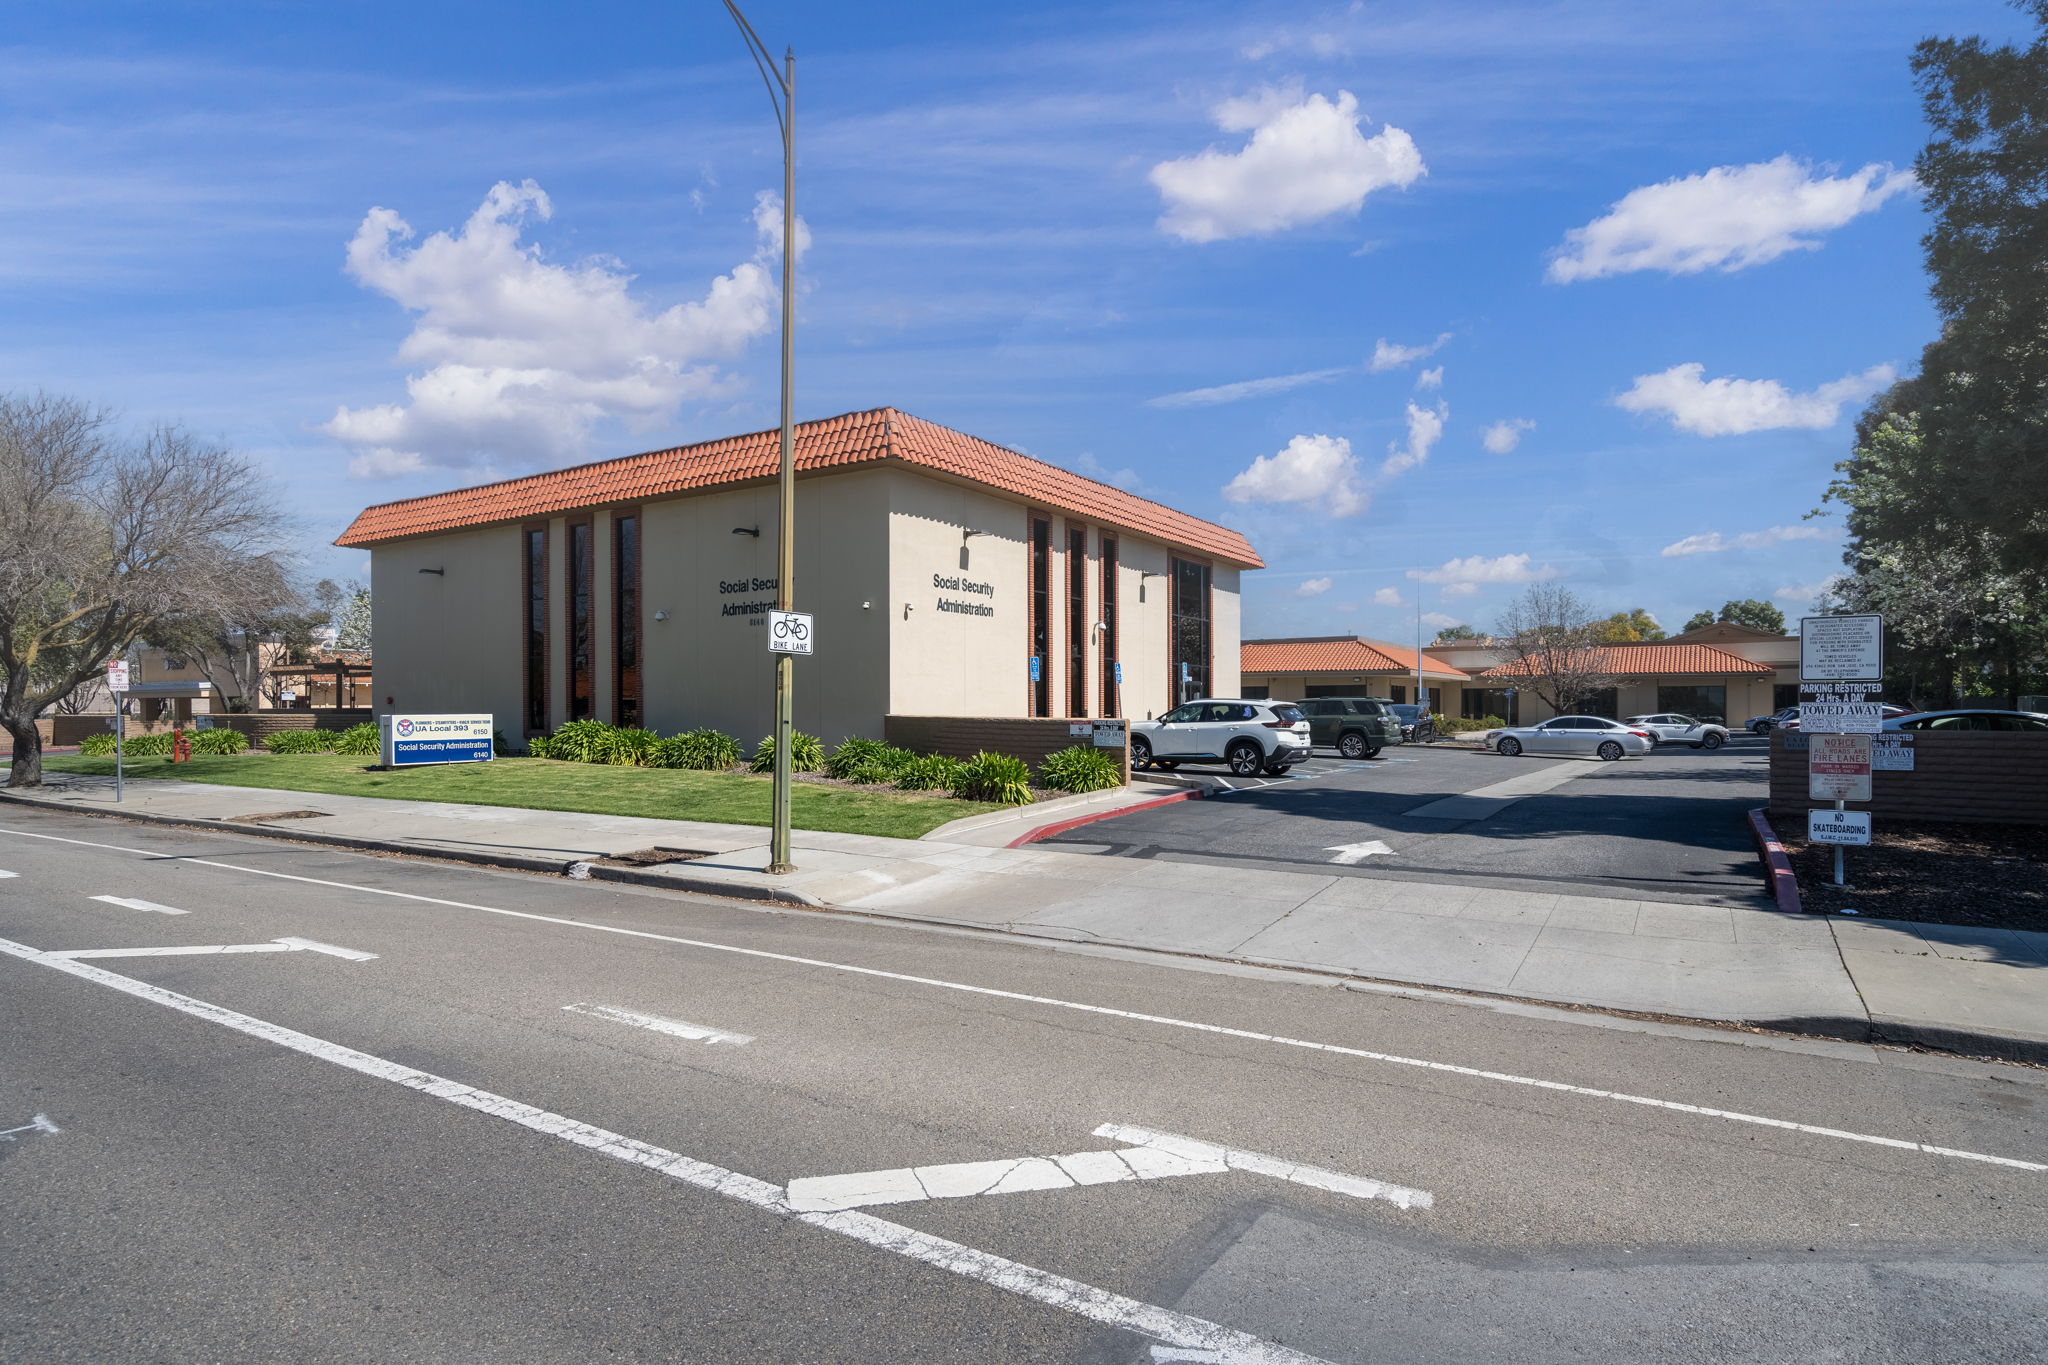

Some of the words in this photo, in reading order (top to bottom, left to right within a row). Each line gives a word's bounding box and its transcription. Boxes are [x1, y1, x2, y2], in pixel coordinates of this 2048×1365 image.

[719, 578, 749, 594] Social
[933, 573, 959, 590] Social
[962, 578, 994, 599] Security
[722, 600, 777, 616] Administrat
[936, 597, 994, 617] Administration
[774, 640, 788, 649] BIKE
[792, 643, 807, 651] LANE
[1800, 684, 1833, 693] PARKING
[1834, 683, 1882, 693] RESTRICTED
[1816, 694, 1825, 702] 24
[1826, 694, 1842, 702] Hrs.
[1843, 693, 1848, 702] A
[1851, 693, 1865, 702] DAY
[1800, 705, 1844, 715] TOWED
[1847, 705, 1880, 715] AWAY
[420, 742, 445, 751] Security
[446, 741, 488, 750] Administration
[1824, 738, 1856, 747] NOTICE
[1834, 814, 1844, 822] NO
[1813, 824, 1866, 834] SKATEBOARDING
